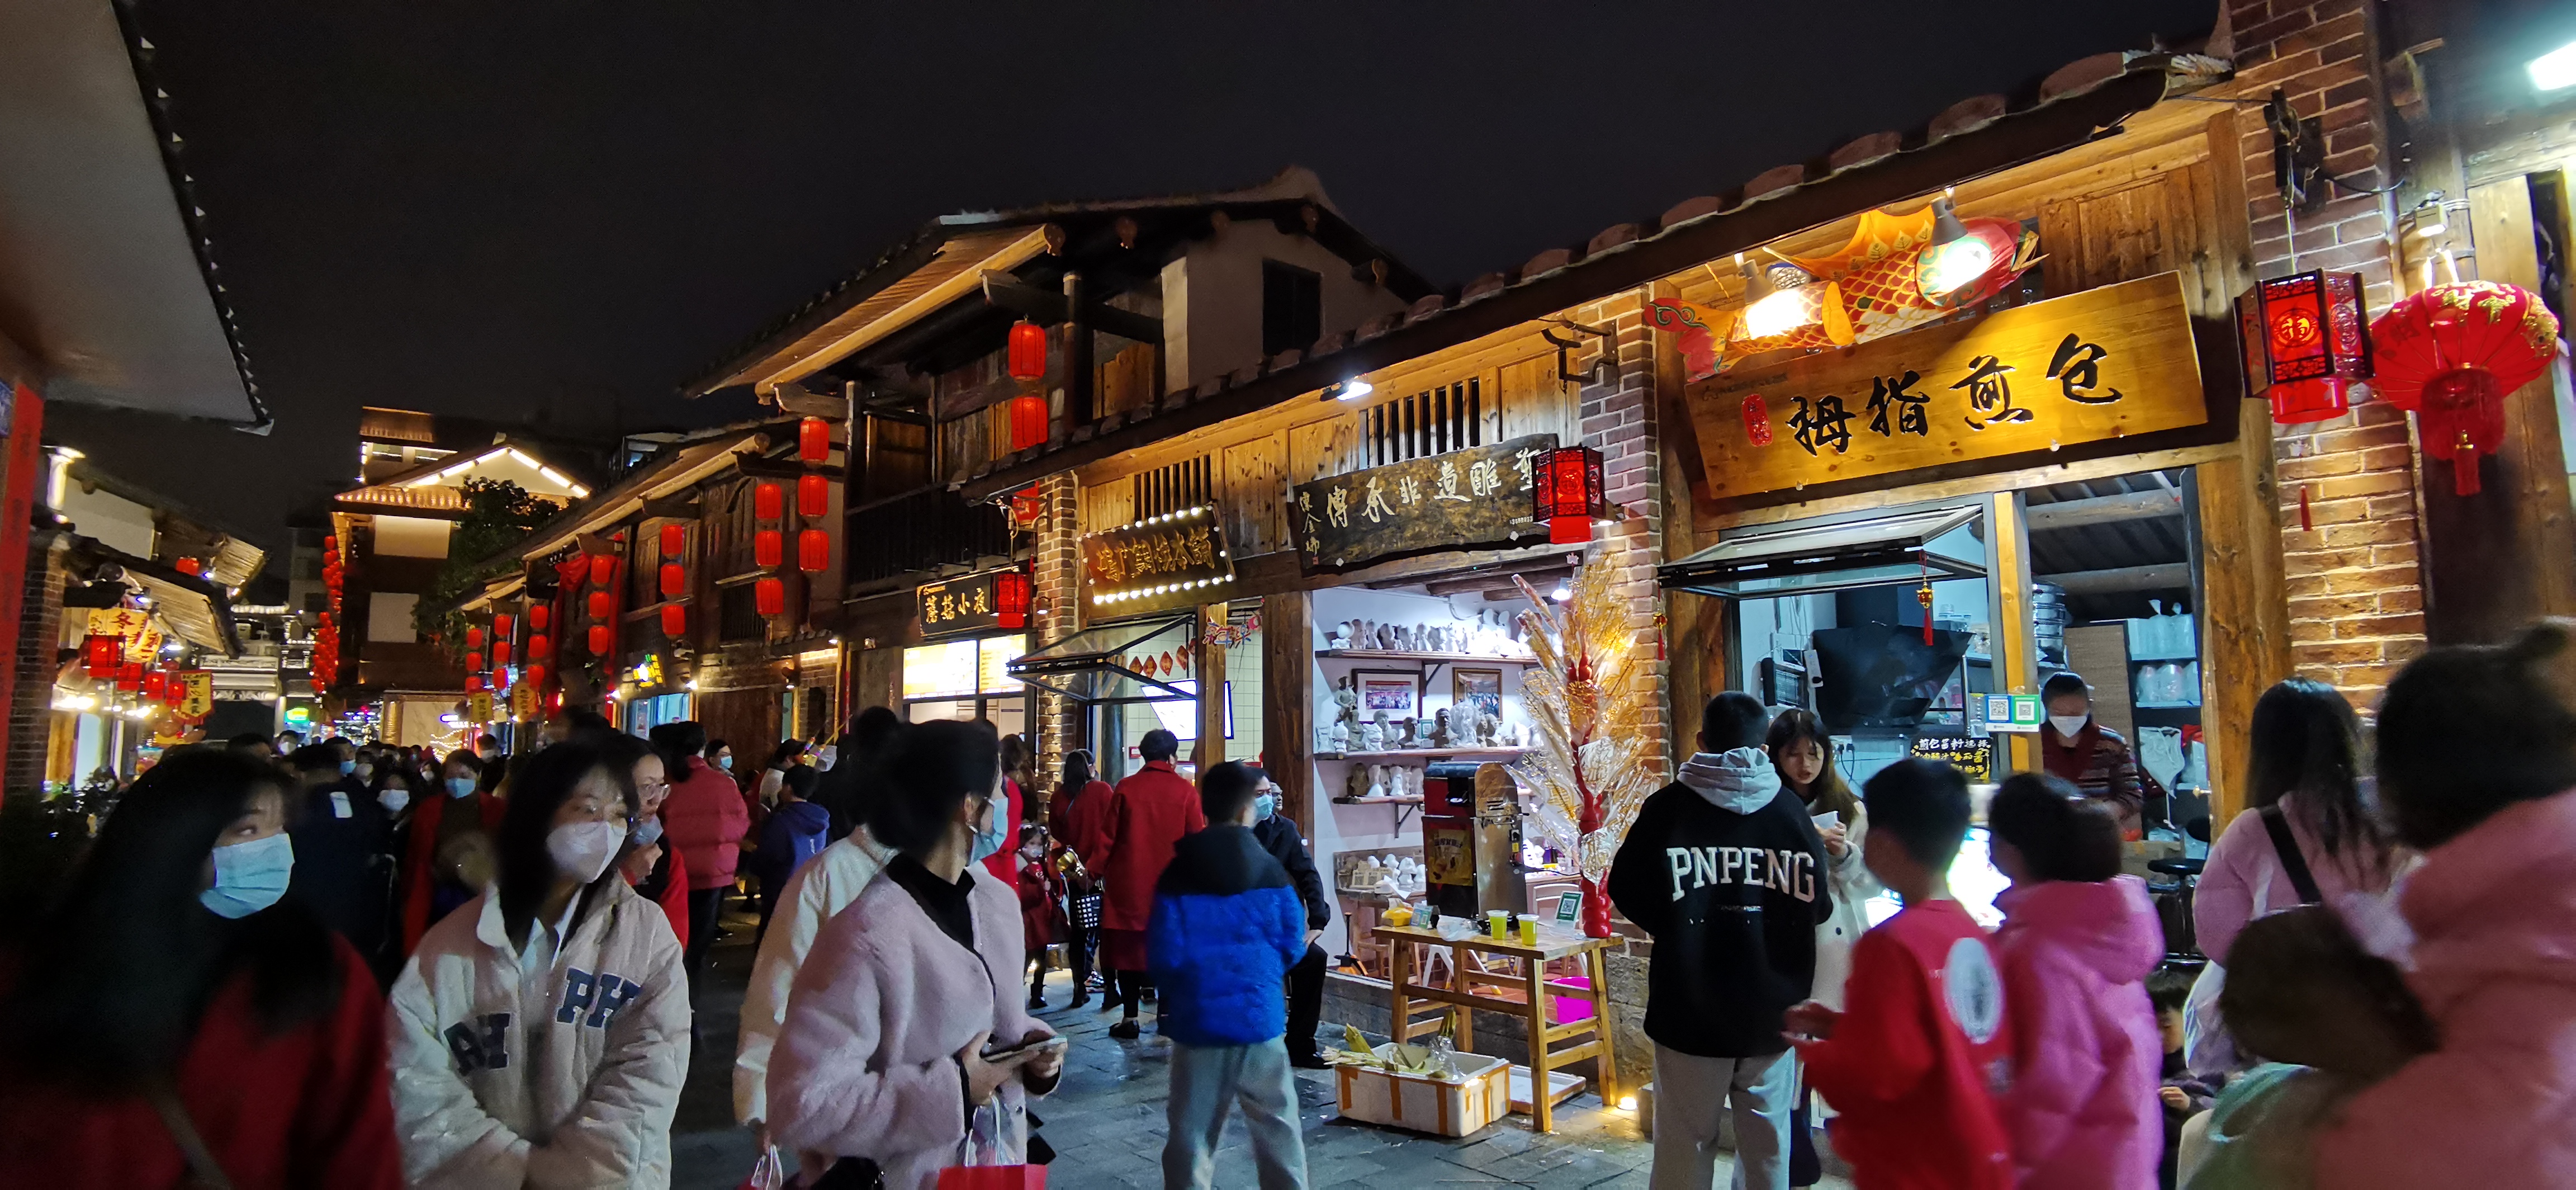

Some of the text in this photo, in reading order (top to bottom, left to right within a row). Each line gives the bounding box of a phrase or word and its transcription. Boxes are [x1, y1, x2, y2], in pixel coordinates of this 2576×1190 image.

[1786, 333, 2123, 457] 拇指煎包
[1666, 847, 1815, 903] PNPENG
